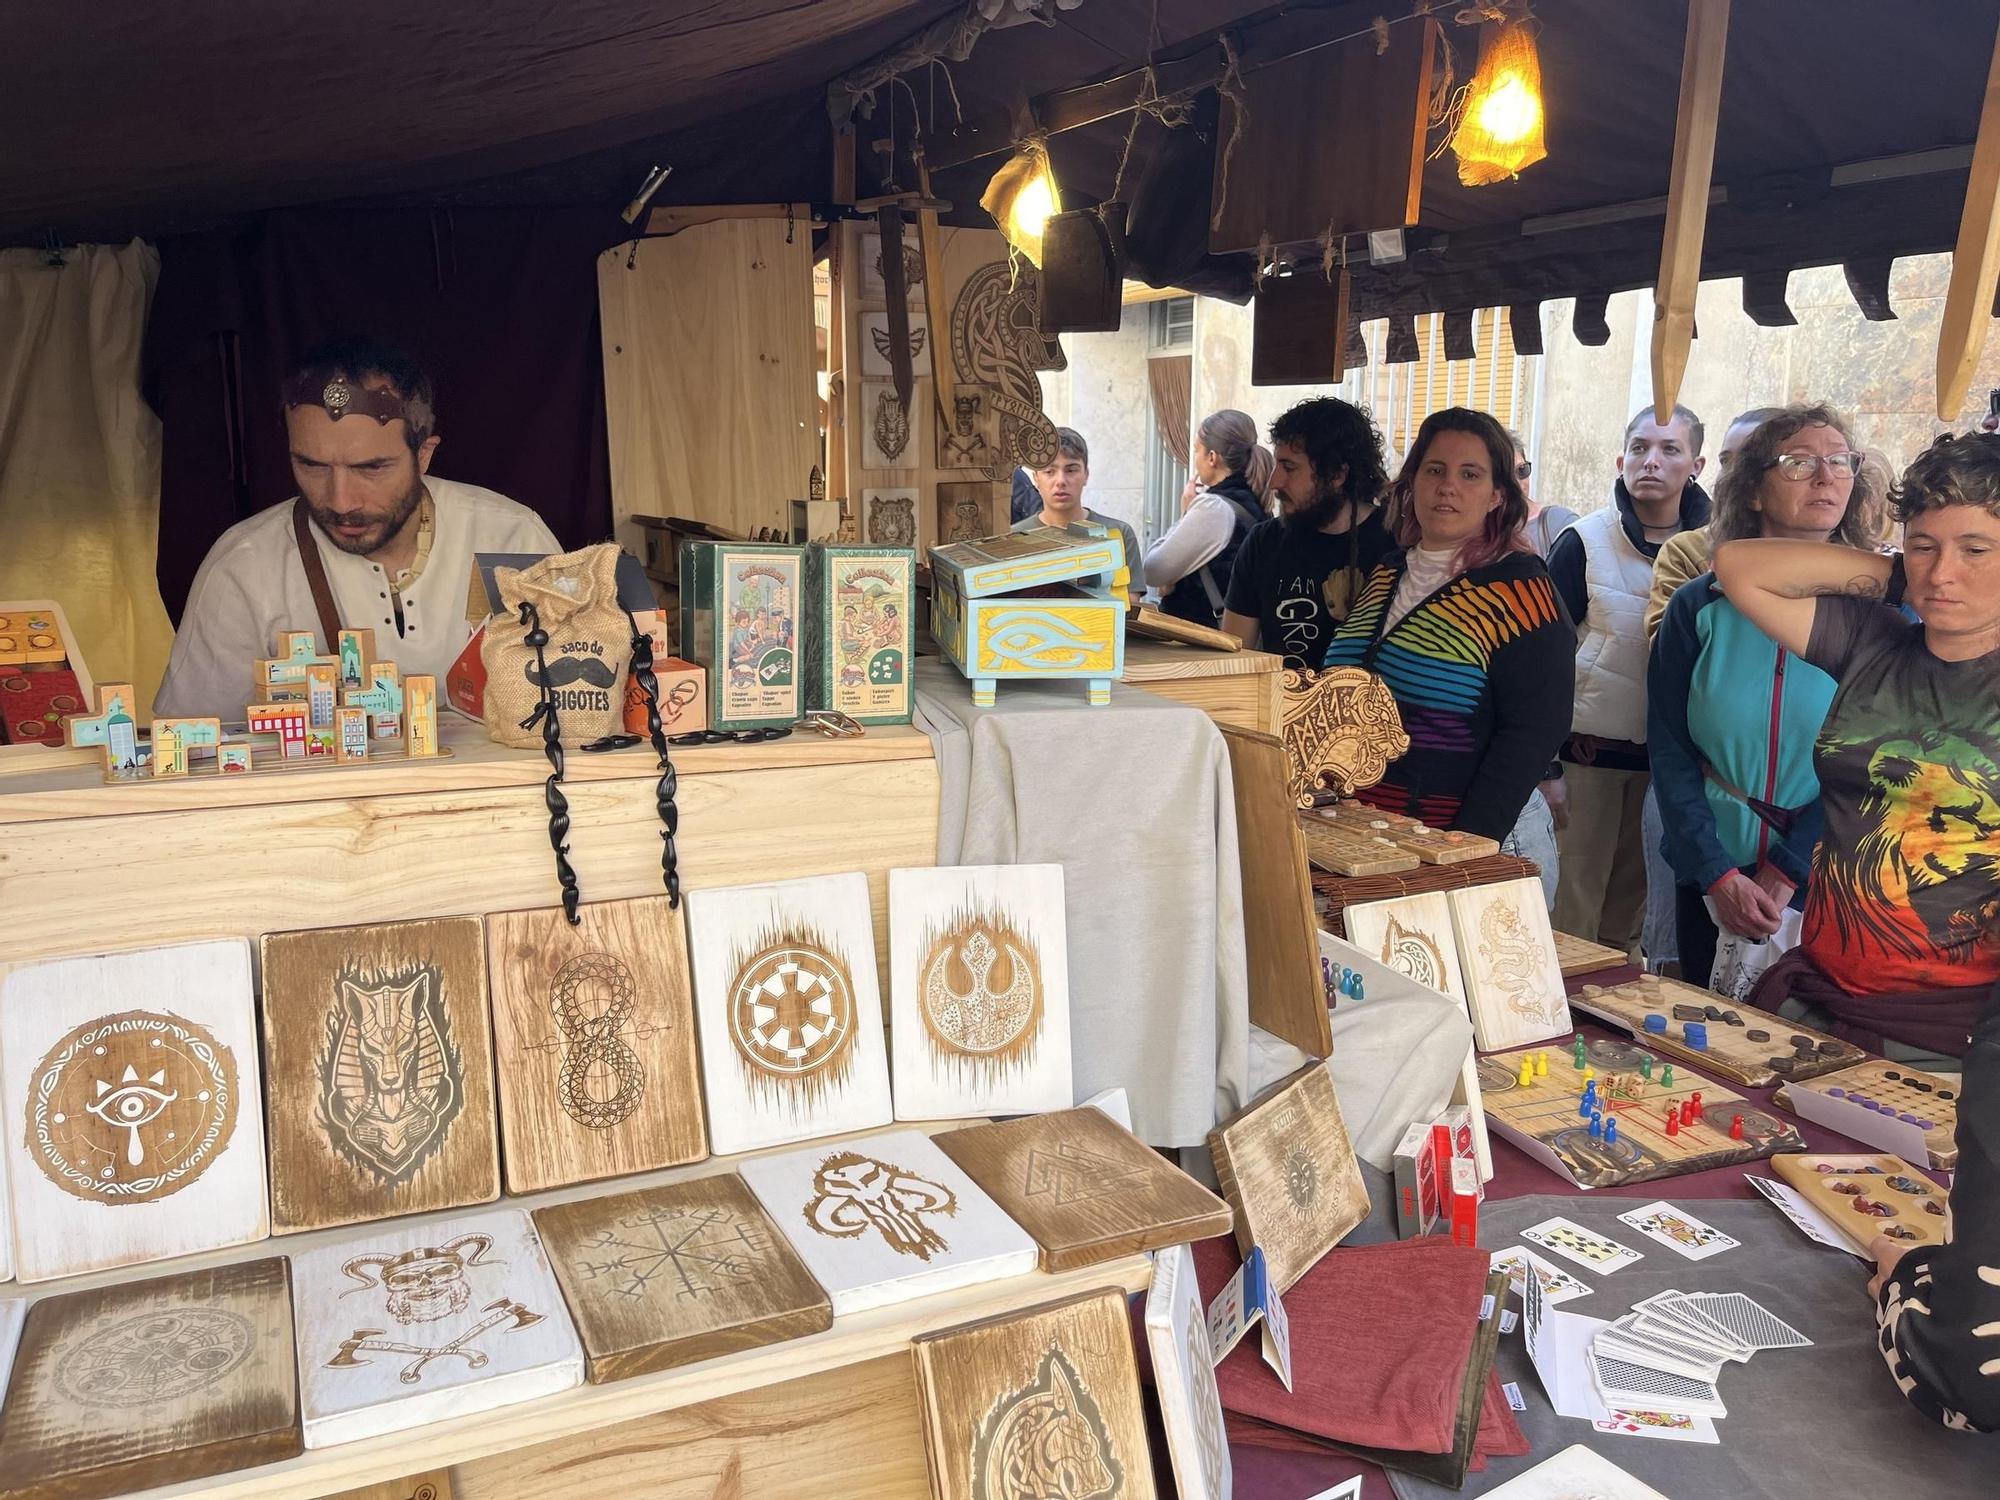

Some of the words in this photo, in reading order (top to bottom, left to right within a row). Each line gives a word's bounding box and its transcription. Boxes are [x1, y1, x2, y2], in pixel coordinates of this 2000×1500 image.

[1290, 576, 1315, 594] AM
[590, 641, 604, 656] de
[551, 689, 610, 711] BIGOTES
